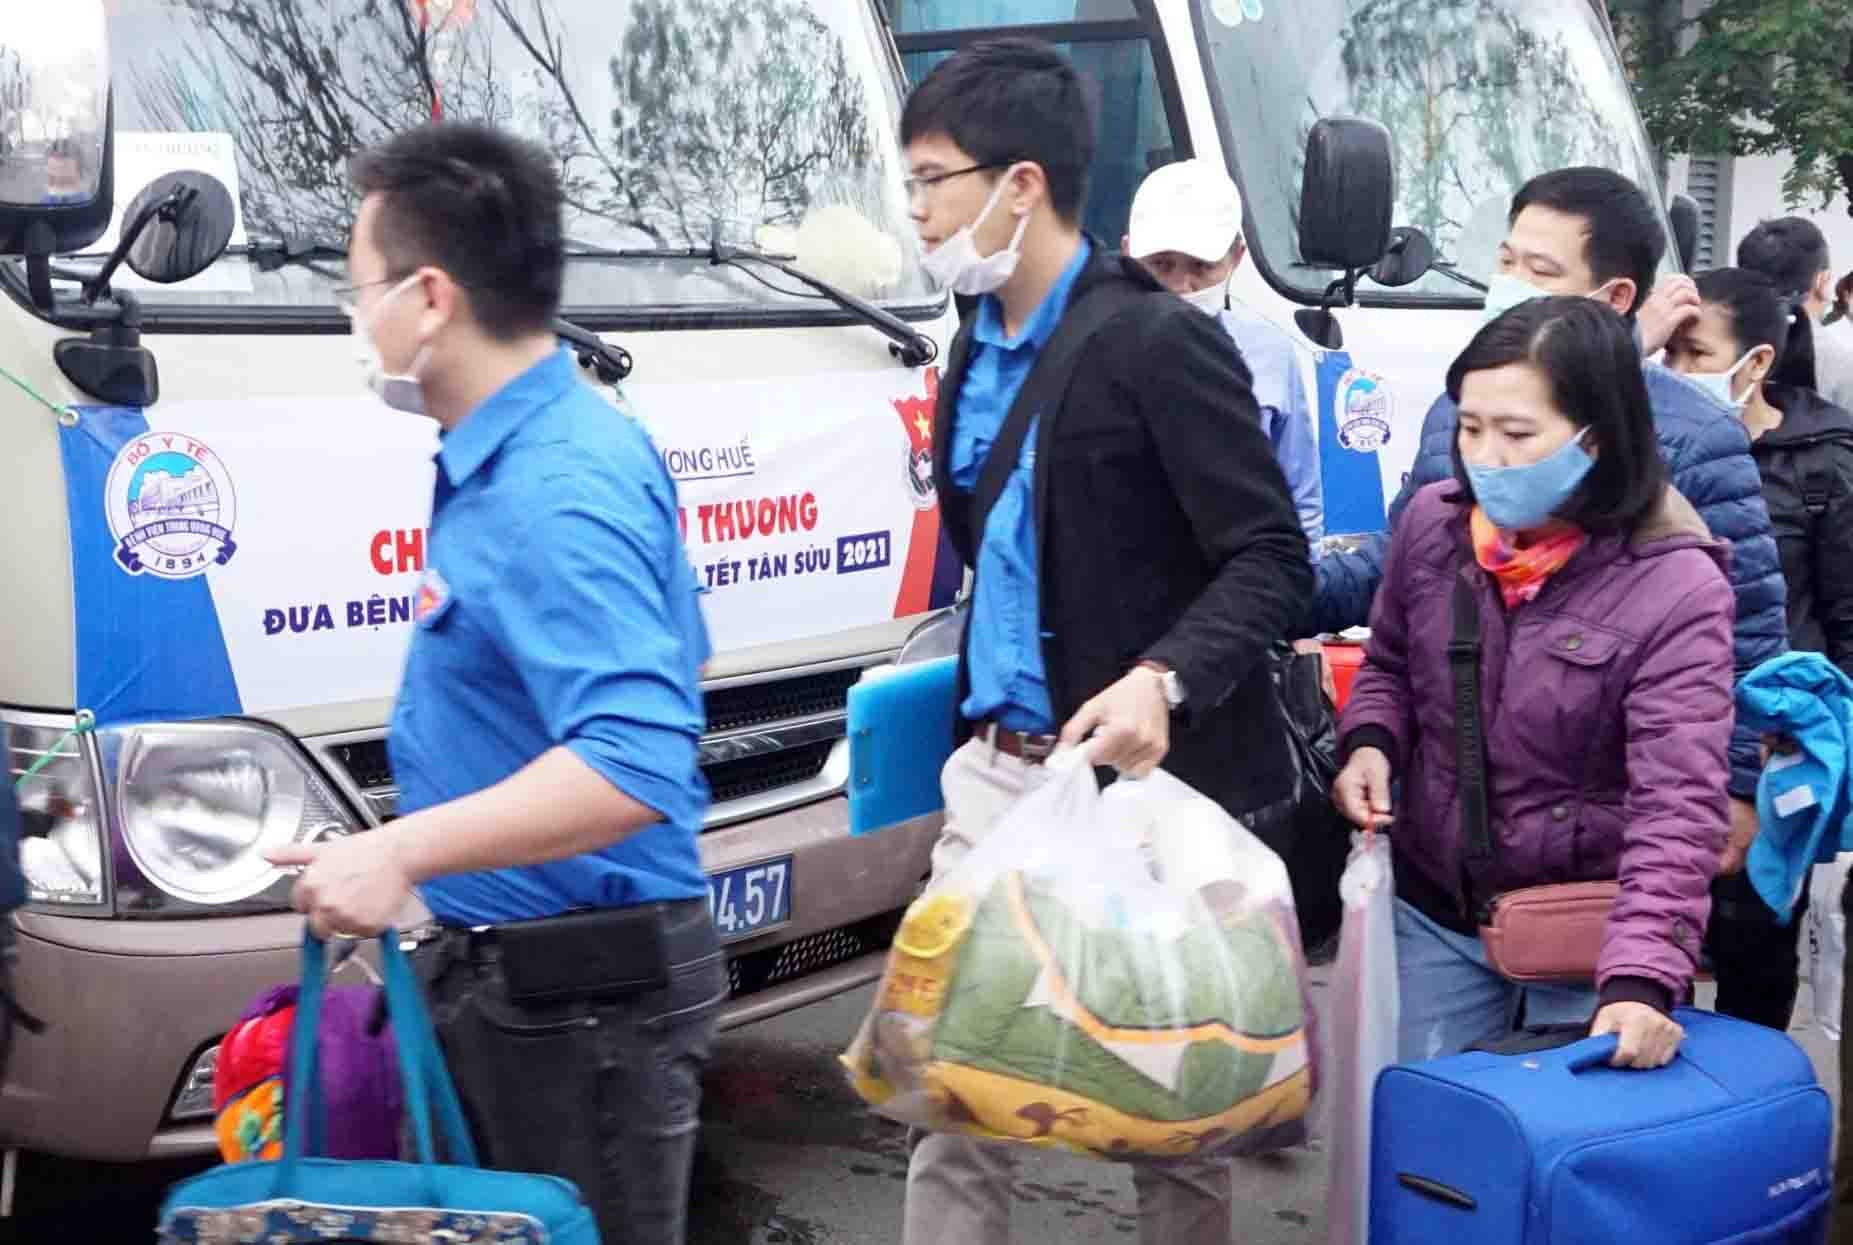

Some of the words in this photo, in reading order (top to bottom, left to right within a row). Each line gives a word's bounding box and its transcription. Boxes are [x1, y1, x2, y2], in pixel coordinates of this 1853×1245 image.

[162, 437, 174, 449] Y
[370, 528, 425, 576] CH
[263, 604, 335, 636] ĐƯA
[346, 593, 416, 632] BỆN
[747, 552, 787, 582] TÂN
[842, 537, 888, 568] 2021
